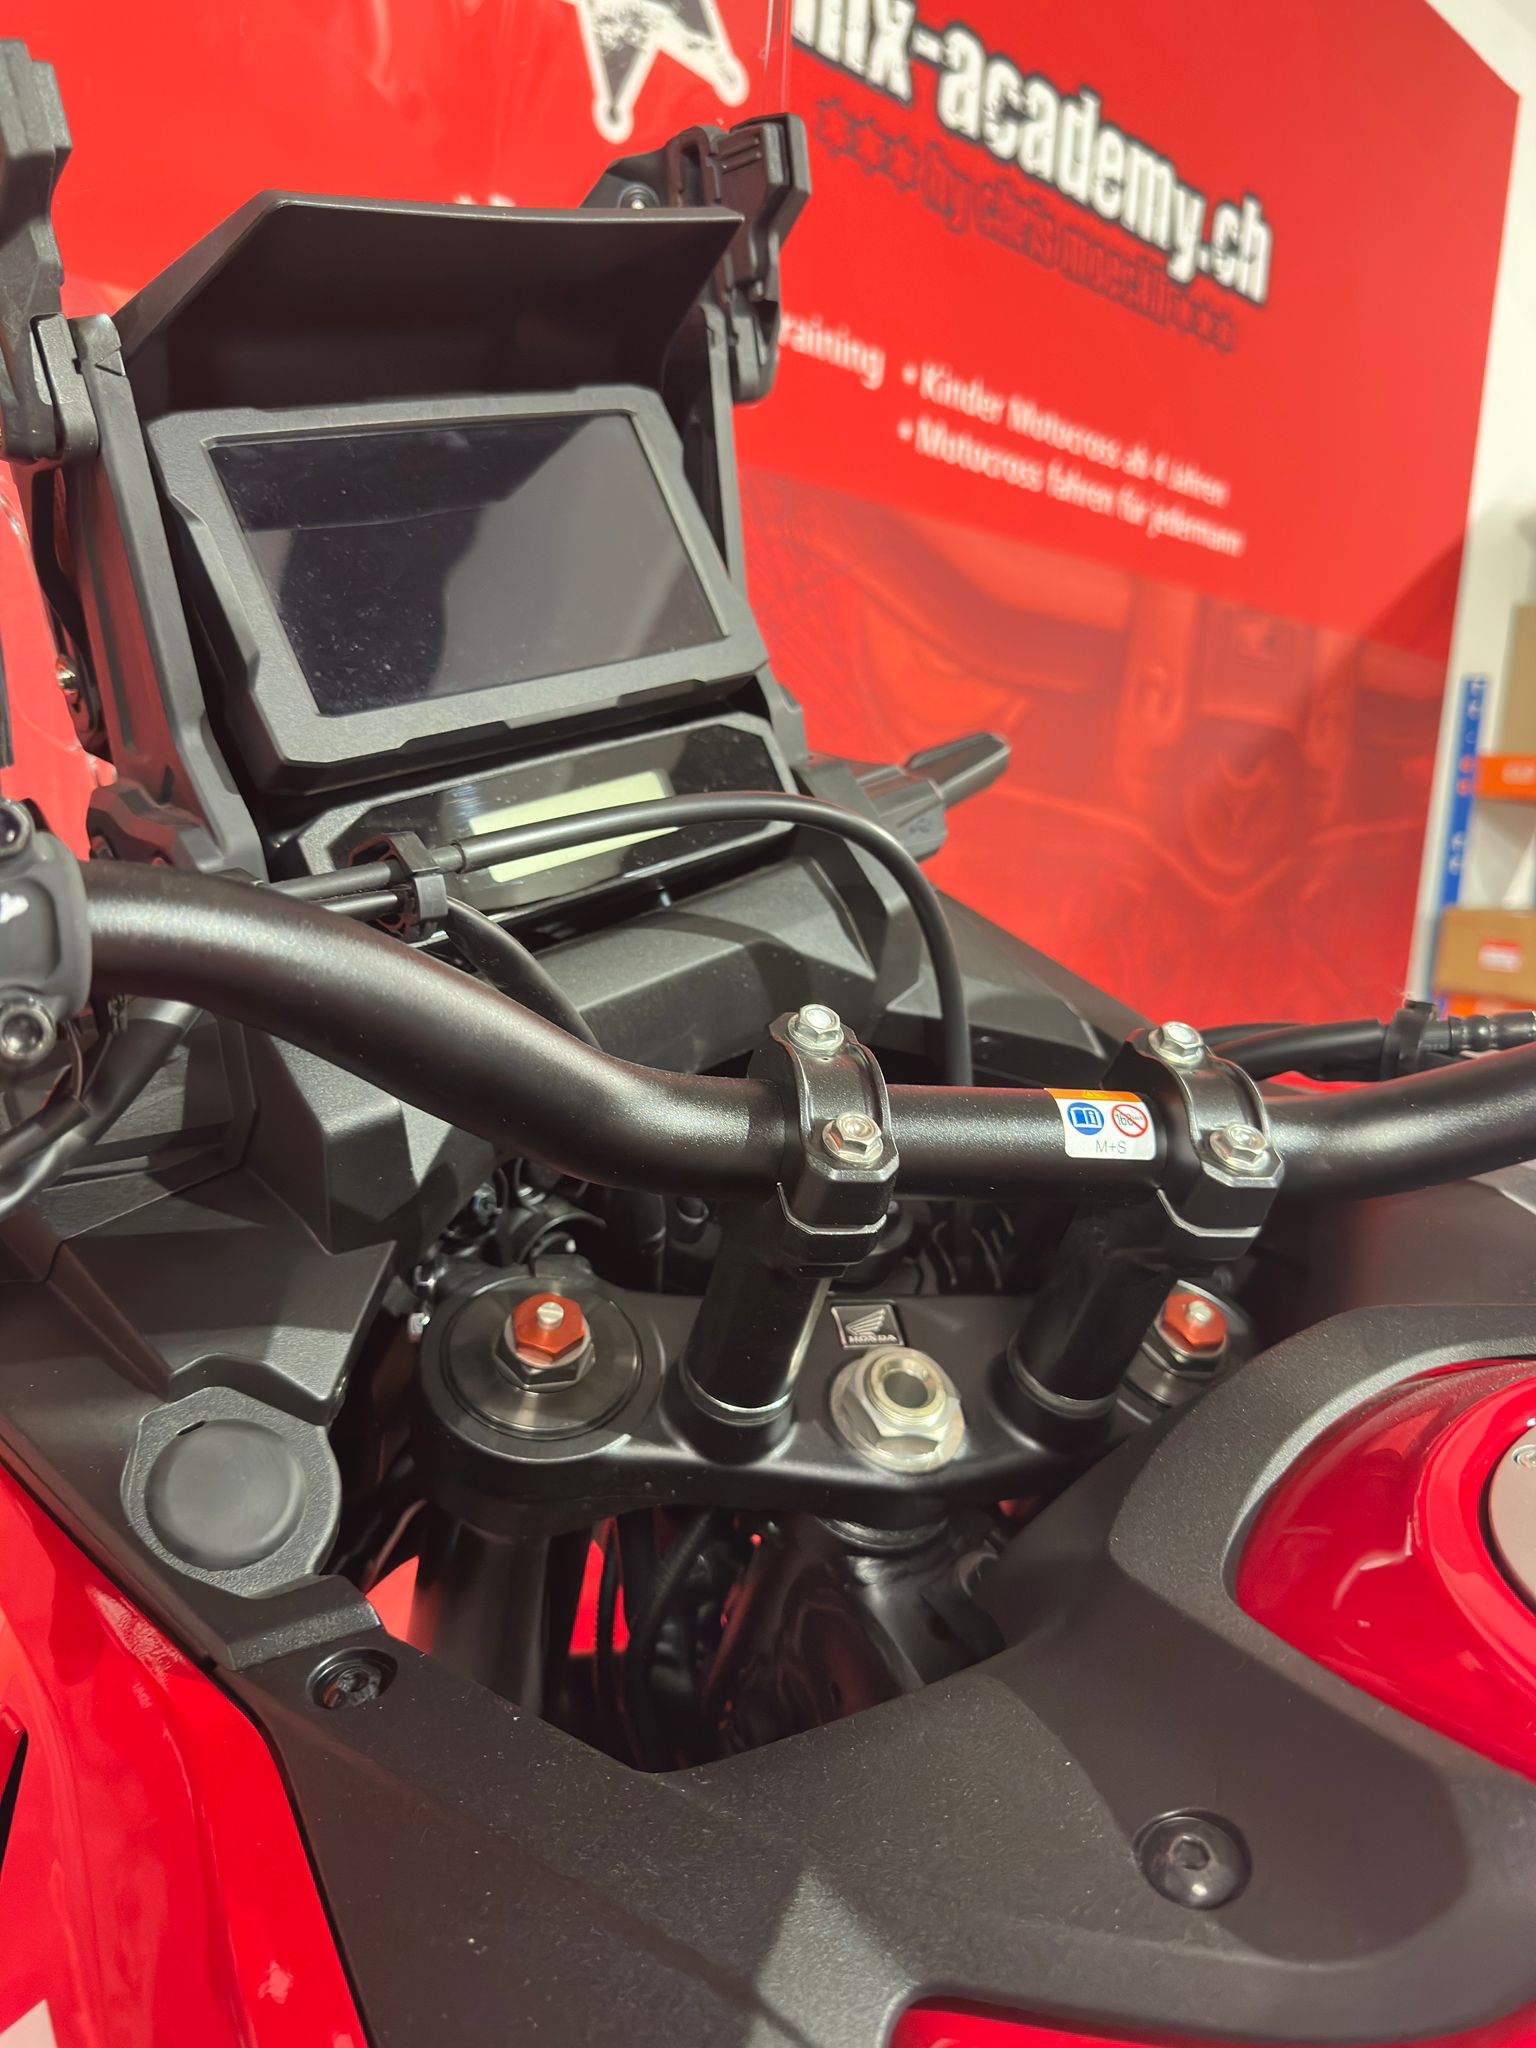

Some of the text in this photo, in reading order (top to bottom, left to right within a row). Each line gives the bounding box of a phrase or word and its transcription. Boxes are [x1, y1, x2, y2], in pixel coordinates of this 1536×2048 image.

[778, 314, 885, 389] raining
[919, 362, 1004, 425] Kinder
[915, 415, 1044, 492] Motocross
[1095, 1140, 1127, 1154] M+S
[848, 1334, 898, 1344] HONDA
